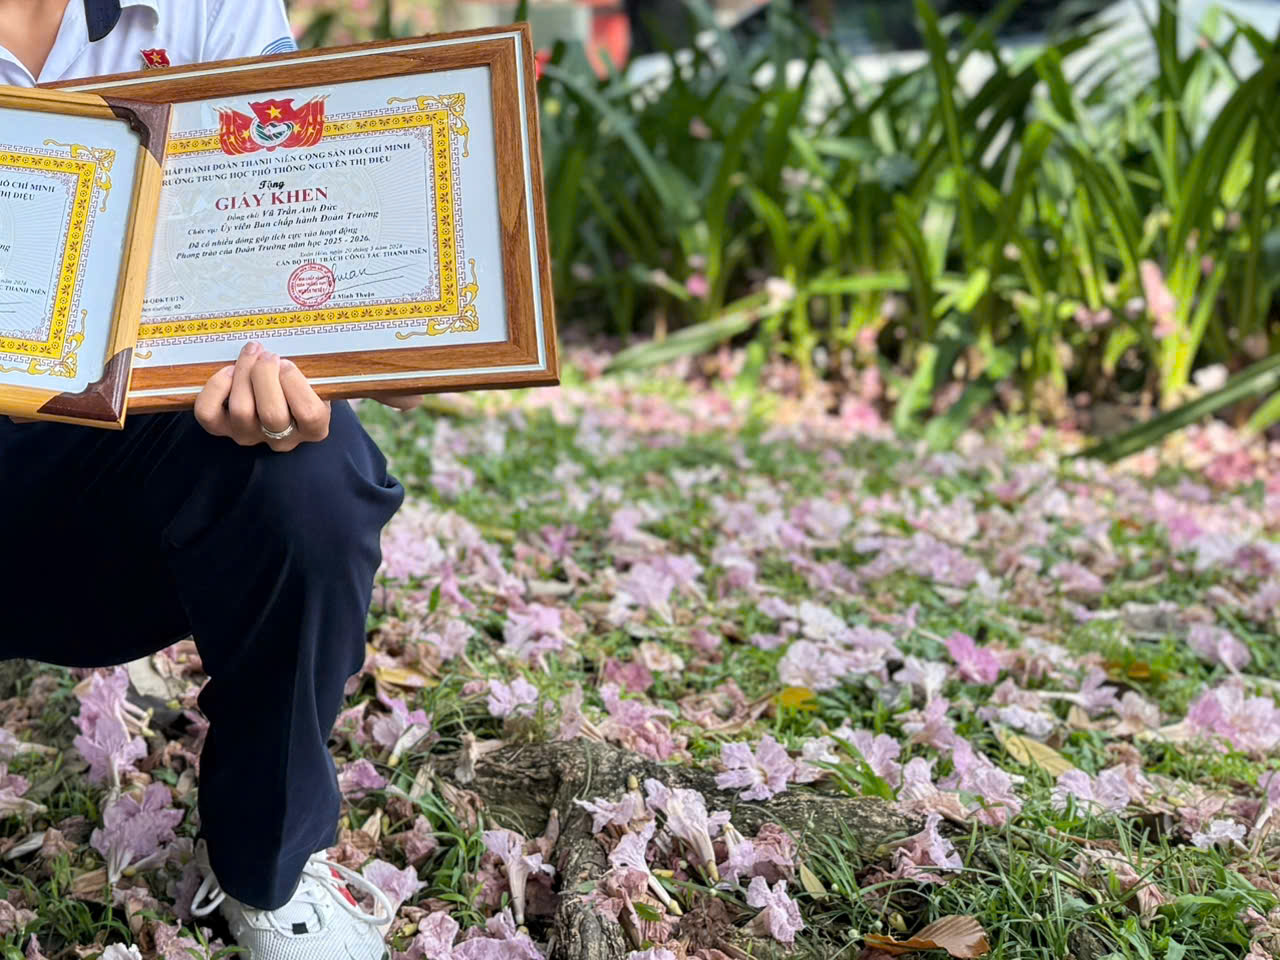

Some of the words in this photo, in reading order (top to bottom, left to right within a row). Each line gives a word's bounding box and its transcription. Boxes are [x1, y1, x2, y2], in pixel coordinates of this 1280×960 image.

[241, 158, 272, 168] THANH
[384, 143, 410, 152] MINH
[161, 178, 194, 187] RƯỜNG
[197, 173, 228, 183] TRUNG
[230, 171, 250, 180] HỌC
[30, 183, 55, 193] MINH
[215, 192, 265, 211] GIẤY
[271, 187, 328, 206] KHEN
[299, 205, 316, 214] Anh
[254, 221, 271, 229] Ban
[324, 237, 342, 246] 2025
[383, 249, 409, 258] THANH
[5, 285, 29, 294] THANH
